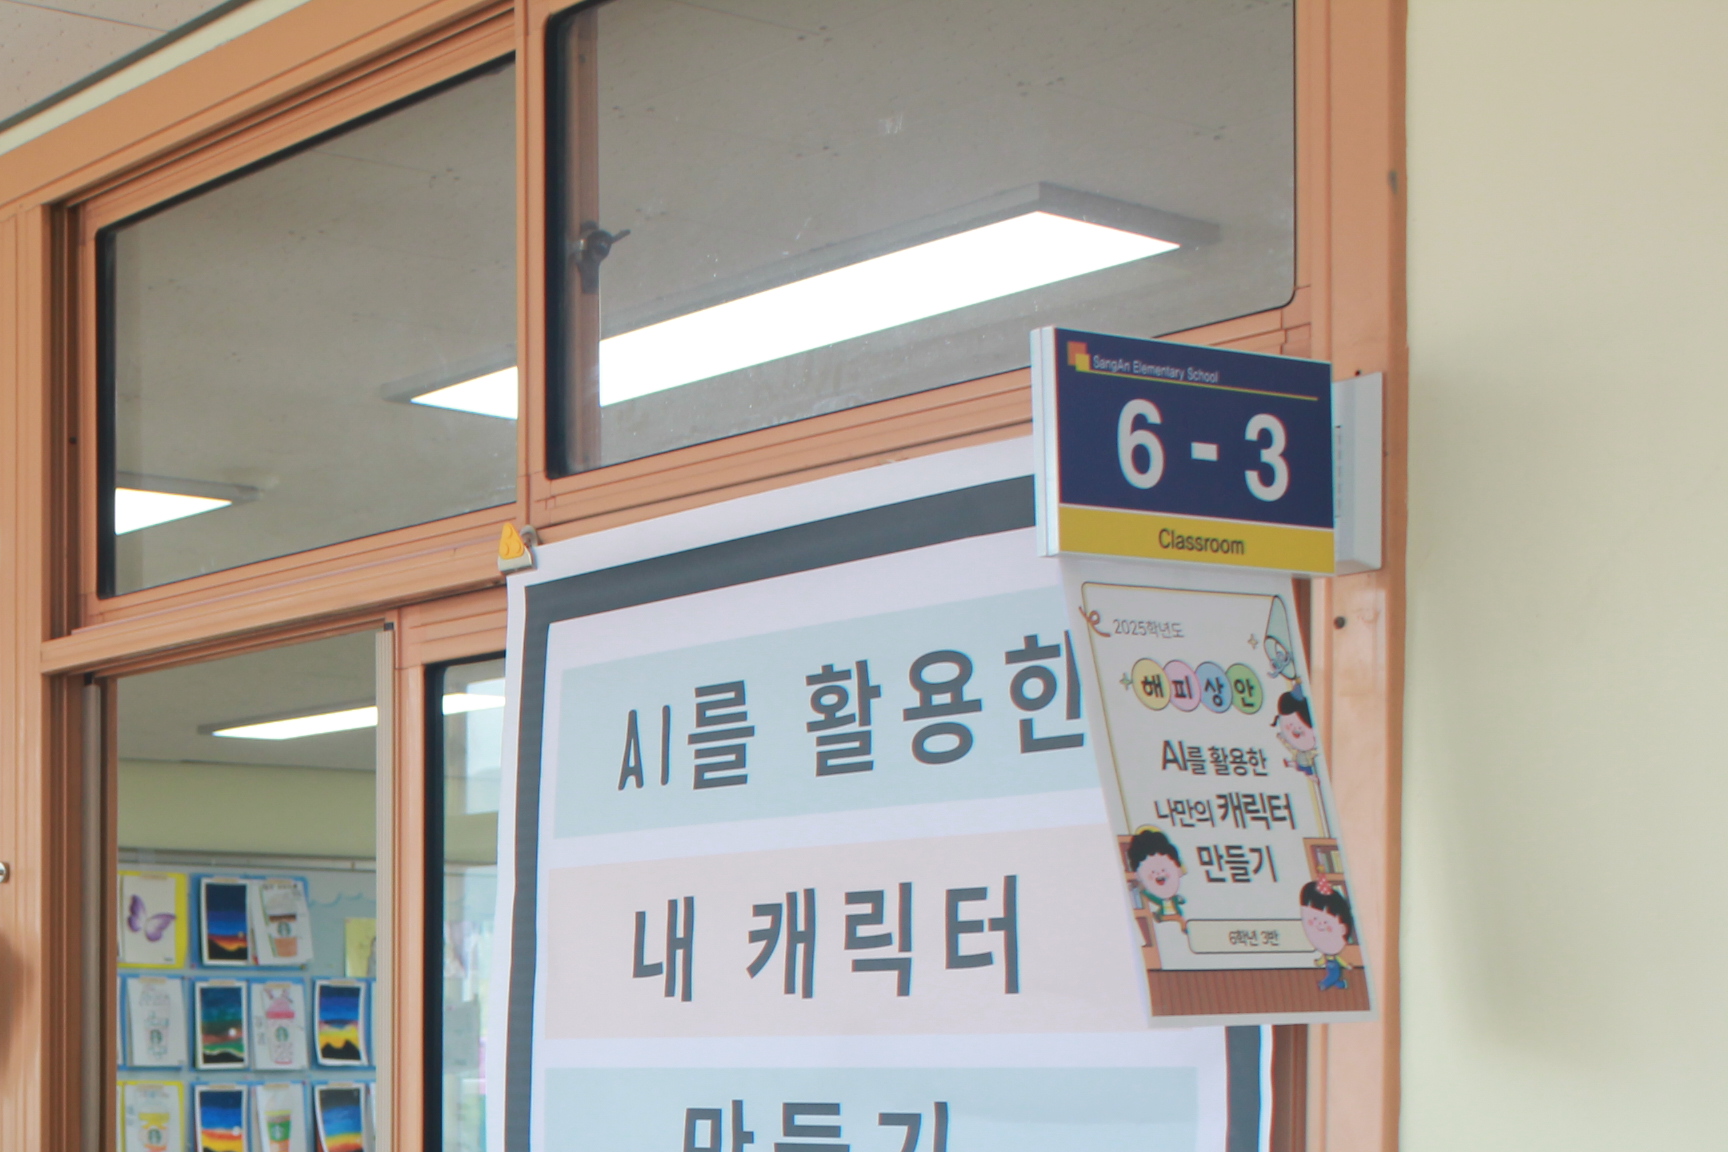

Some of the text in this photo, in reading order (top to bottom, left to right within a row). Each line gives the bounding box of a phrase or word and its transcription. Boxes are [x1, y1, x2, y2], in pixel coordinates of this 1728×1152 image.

[1093, 354, 1219, 383] SangAn Elementary School
[1117, 398, 1165, 489] 6
[1244, 413, 1290, 501] 3
[1158, 528, 1245, 555] Classroom
[1113, 618, 1185, 639] 2025학년도
[1140, 673, 1255, 708] 해피상안
[617, 679, 755, 791] AI를
[1162, 739, 1268, 777] AI를 활용한
[1154, 791, 1296, 831] 나만의 캐릭터
[1196, 844, 1278, 883] 만들기
[632, 874, 1021, 1003] 내 캐릭터
[1260, 929, 1280, 947] 3반
